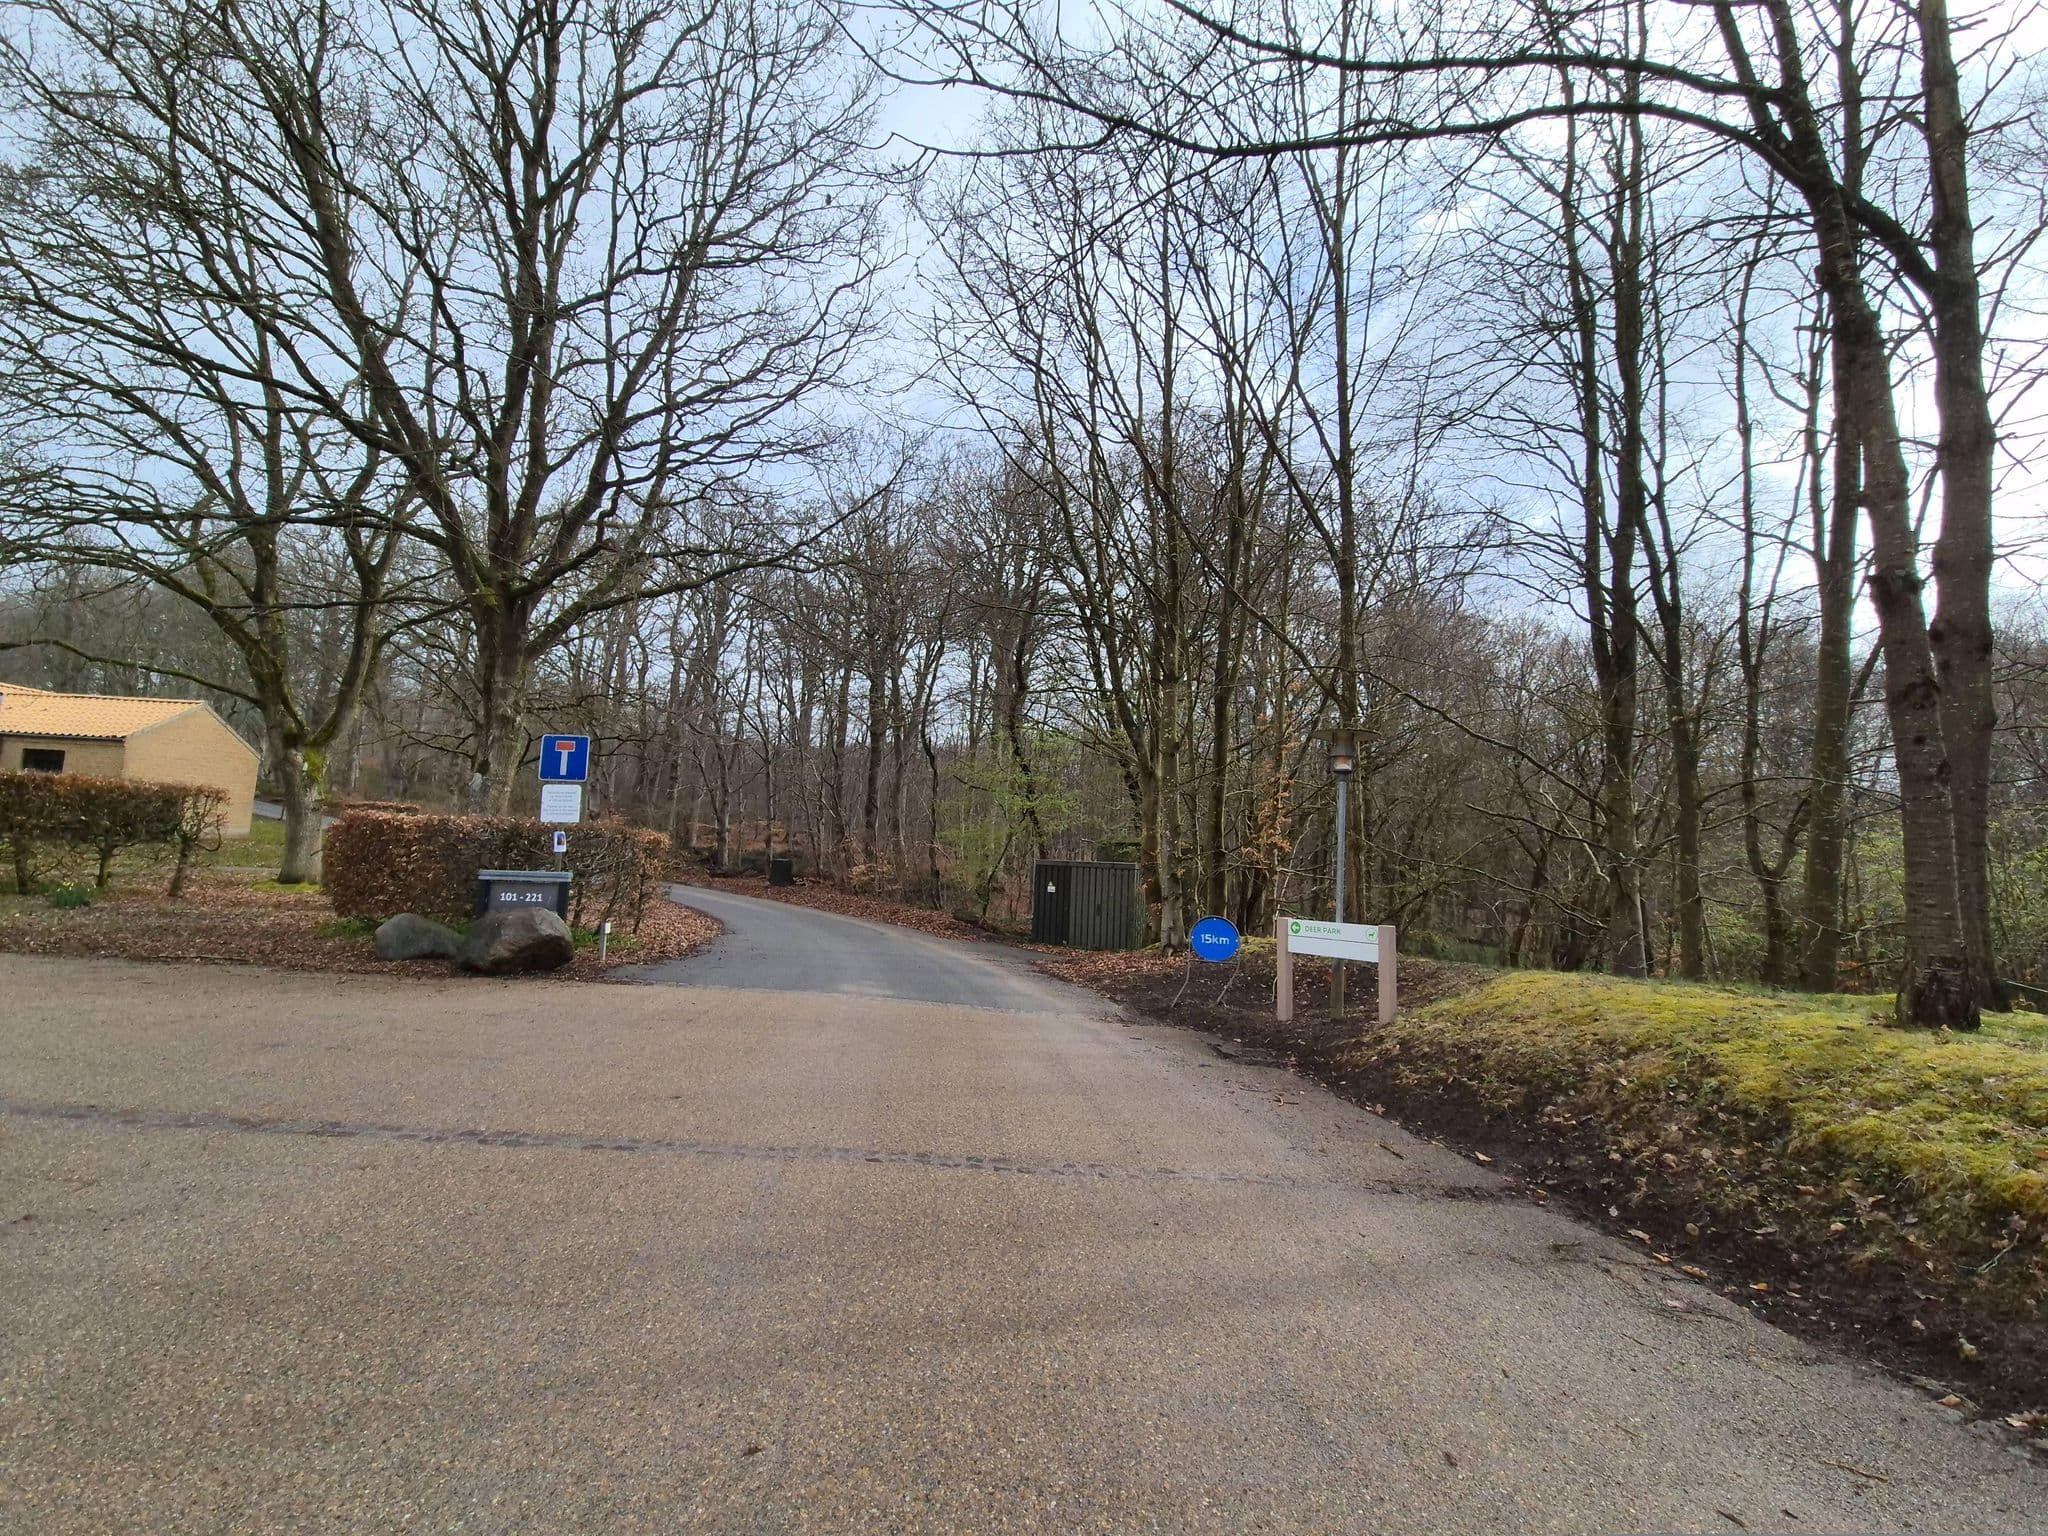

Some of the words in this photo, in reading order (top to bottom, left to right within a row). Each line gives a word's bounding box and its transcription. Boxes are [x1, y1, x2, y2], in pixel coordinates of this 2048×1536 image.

[500, 892, 517, 901] 101
[525, 893, 543, 902] 221
[1304, 925, 1321, 933] DEER
[1323, 927, 1342, 936] PARK
[1200, 933, 1230, 945] 15km
